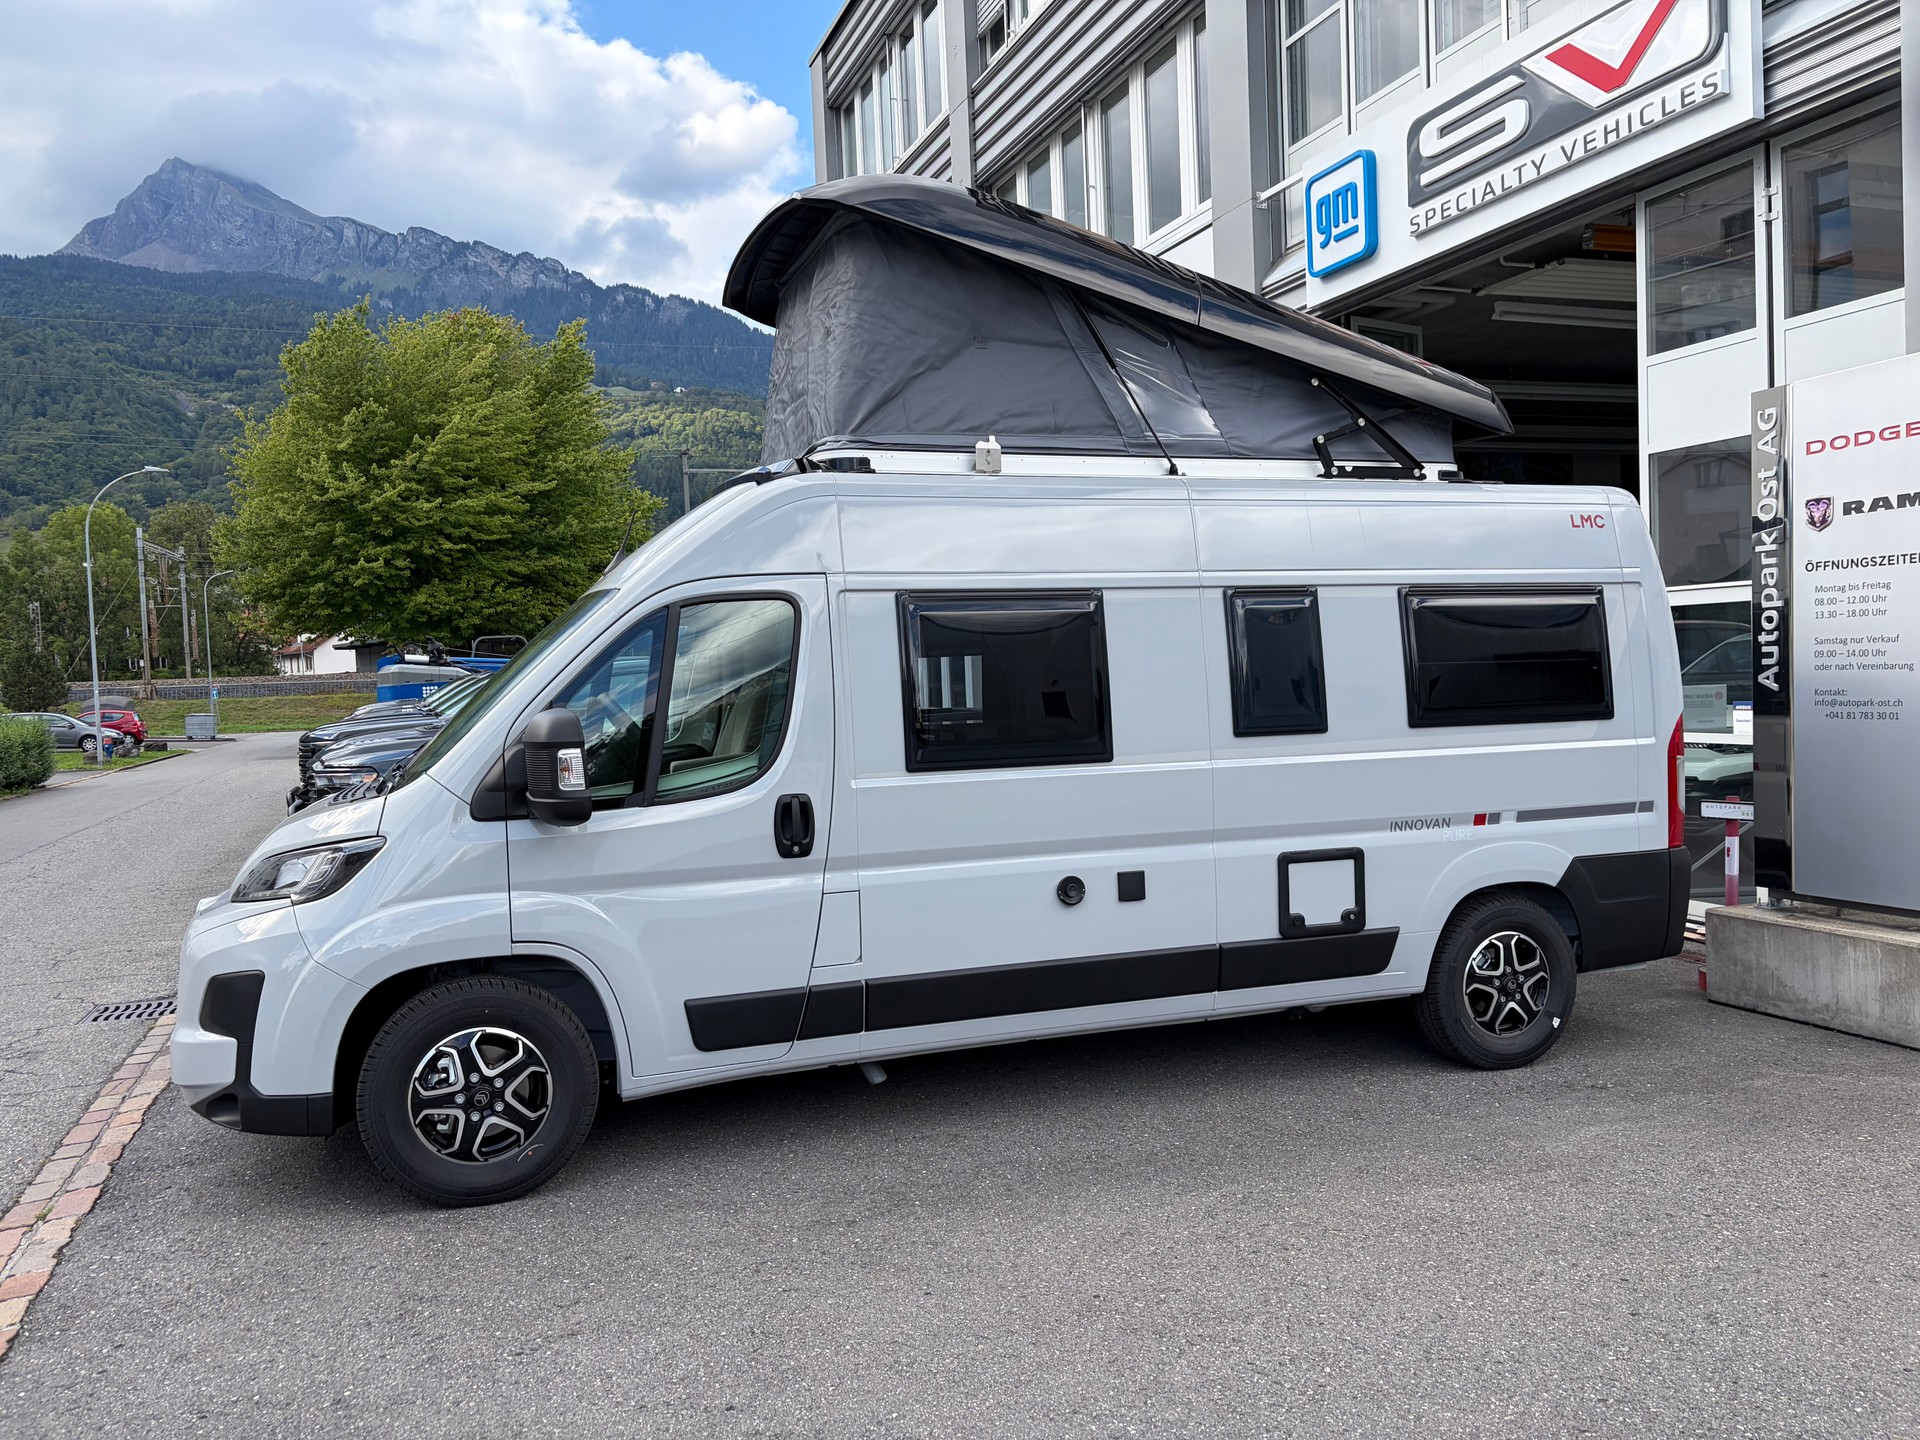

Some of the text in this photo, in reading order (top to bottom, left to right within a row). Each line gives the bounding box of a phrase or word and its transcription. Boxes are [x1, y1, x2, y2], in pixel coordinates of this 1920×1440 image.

[1409, 71, 1719, 237] SPECIALTY VEHICLES
[1316, 181, 1358, 249] gm
[1806, 420, 1920, 456] DODGE
[1843, 491, 1920, 516] RAM
[1570, 514, 1605, 528] LMC
[1755, 407, 1784, 692] Autopark Ost AG
[1805, 551, 1920, 573] ÖFFNUNGSZEITE
[1814, 580, 1892, 593] Montag bis Freitag
[1814, 597, 1838, 606] 08.00
[1846, 595, 1870, 605] 12.00
[1871, 594, 1888, 603] Uhr
[1815, 610, 1838, 619] 13.30
[1846, 608, 1870, 618] 18.00
[1871, 608, 1888, 616] Uhr
[1814, 636, 1848, 646] Samstag
[1866, 634, 1900, 643] Verkauf
[1814, 649, 1837, 658] 09.00
[1846, 649, 1870, 657] 14.00
[1871, 648, 1887, 657] Uhr
[1814, 661, 1915, 672] oder nach Vereinbarung
[1814, 688, 1848, 696] Kontakt:
[1814, 698, 1903, 708] info@autopark-ost.ch
[1825, 711, 1900, 720] +041 81 783 30 01
[1389, 817, 1451, 832] INNOVAN
[1442, 828, 1473, 842] PURE
